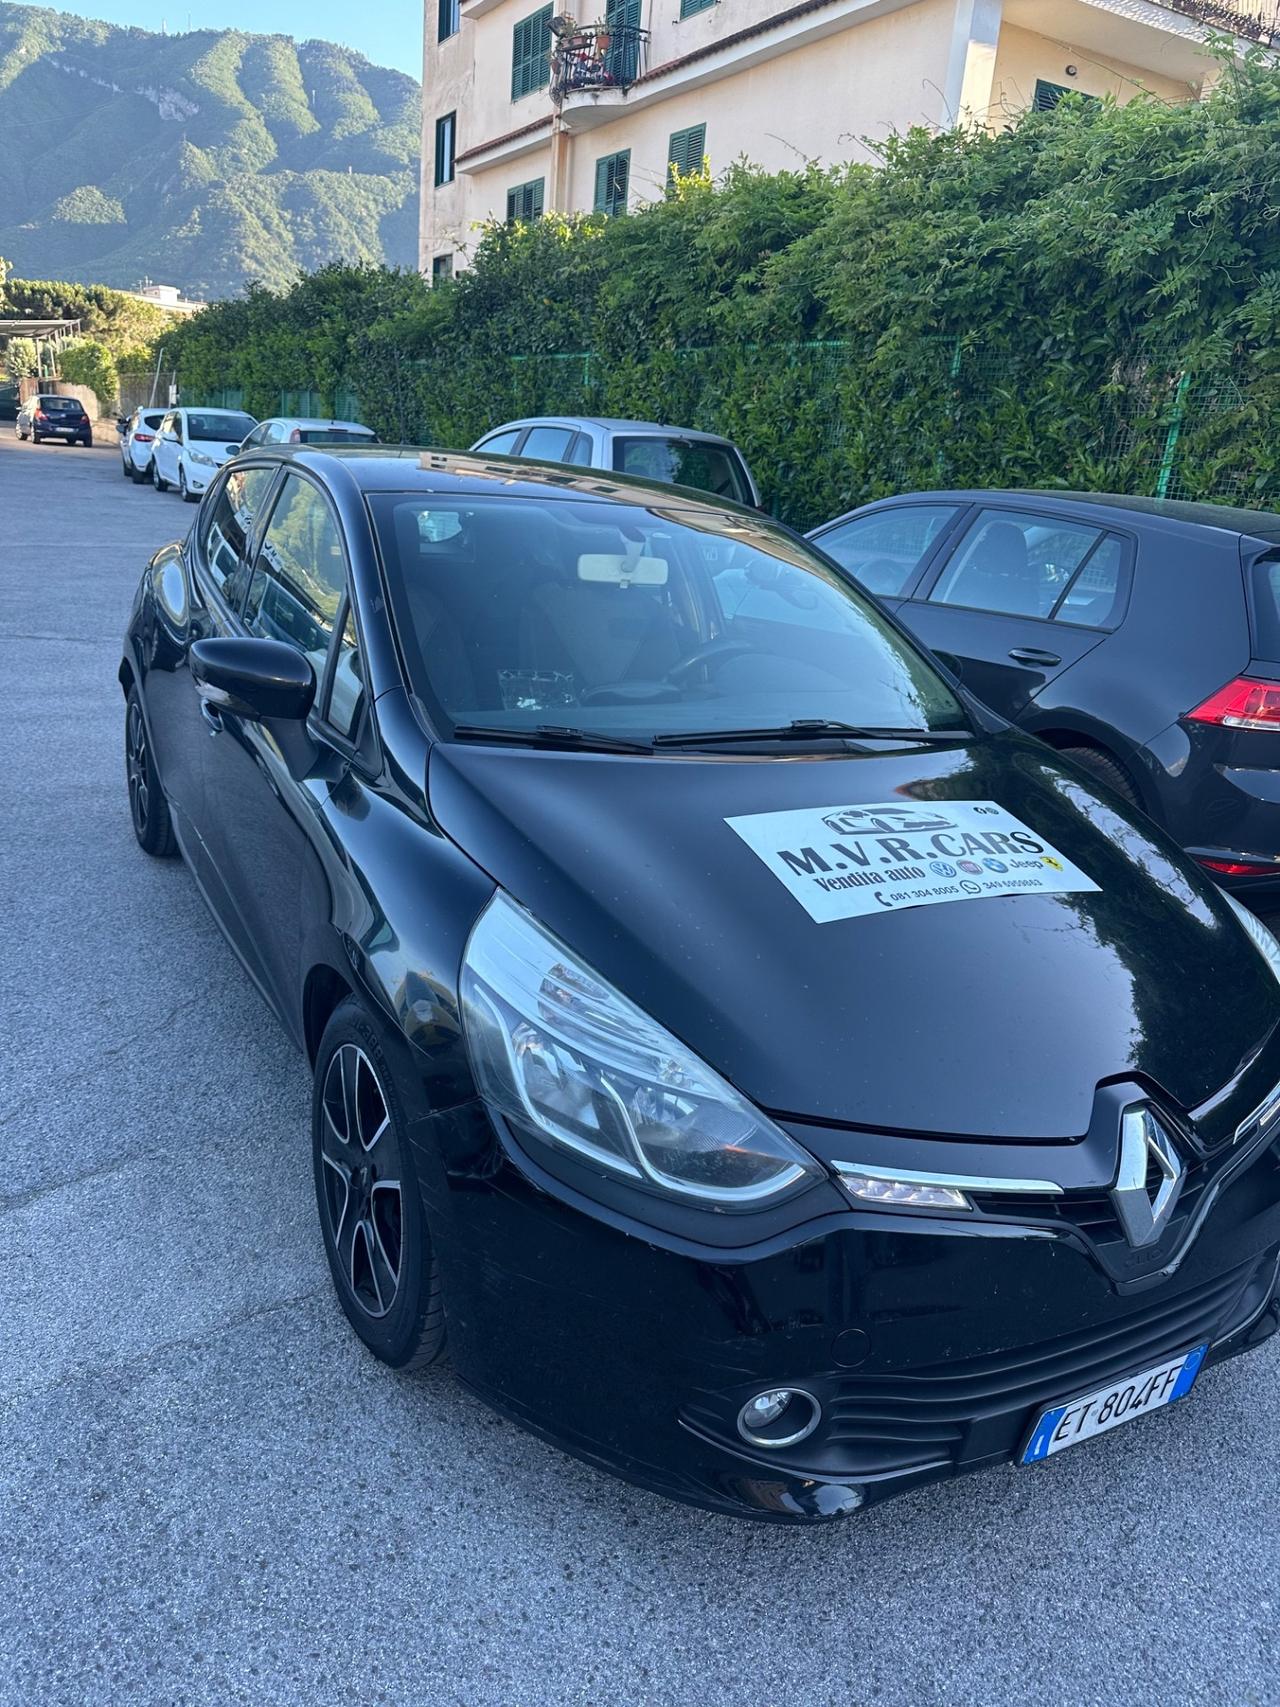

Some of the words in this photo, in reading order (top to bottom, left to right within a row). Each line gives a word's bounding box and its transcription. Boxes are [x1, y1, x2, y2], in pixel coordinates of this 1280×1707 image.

[813, 871, 886, 892] Vendita
[885, 866, 926, 882] auto
[1010, 858, 1044, 870] Jeep
[889, 891, 912, 901] 081
[911, 888, 933, 898] 304
[932, 885, 959, 895] 8005
[1054, 1400, 1097, 1442] ET
[1097, 1363, 1183, 1425] 804FF
